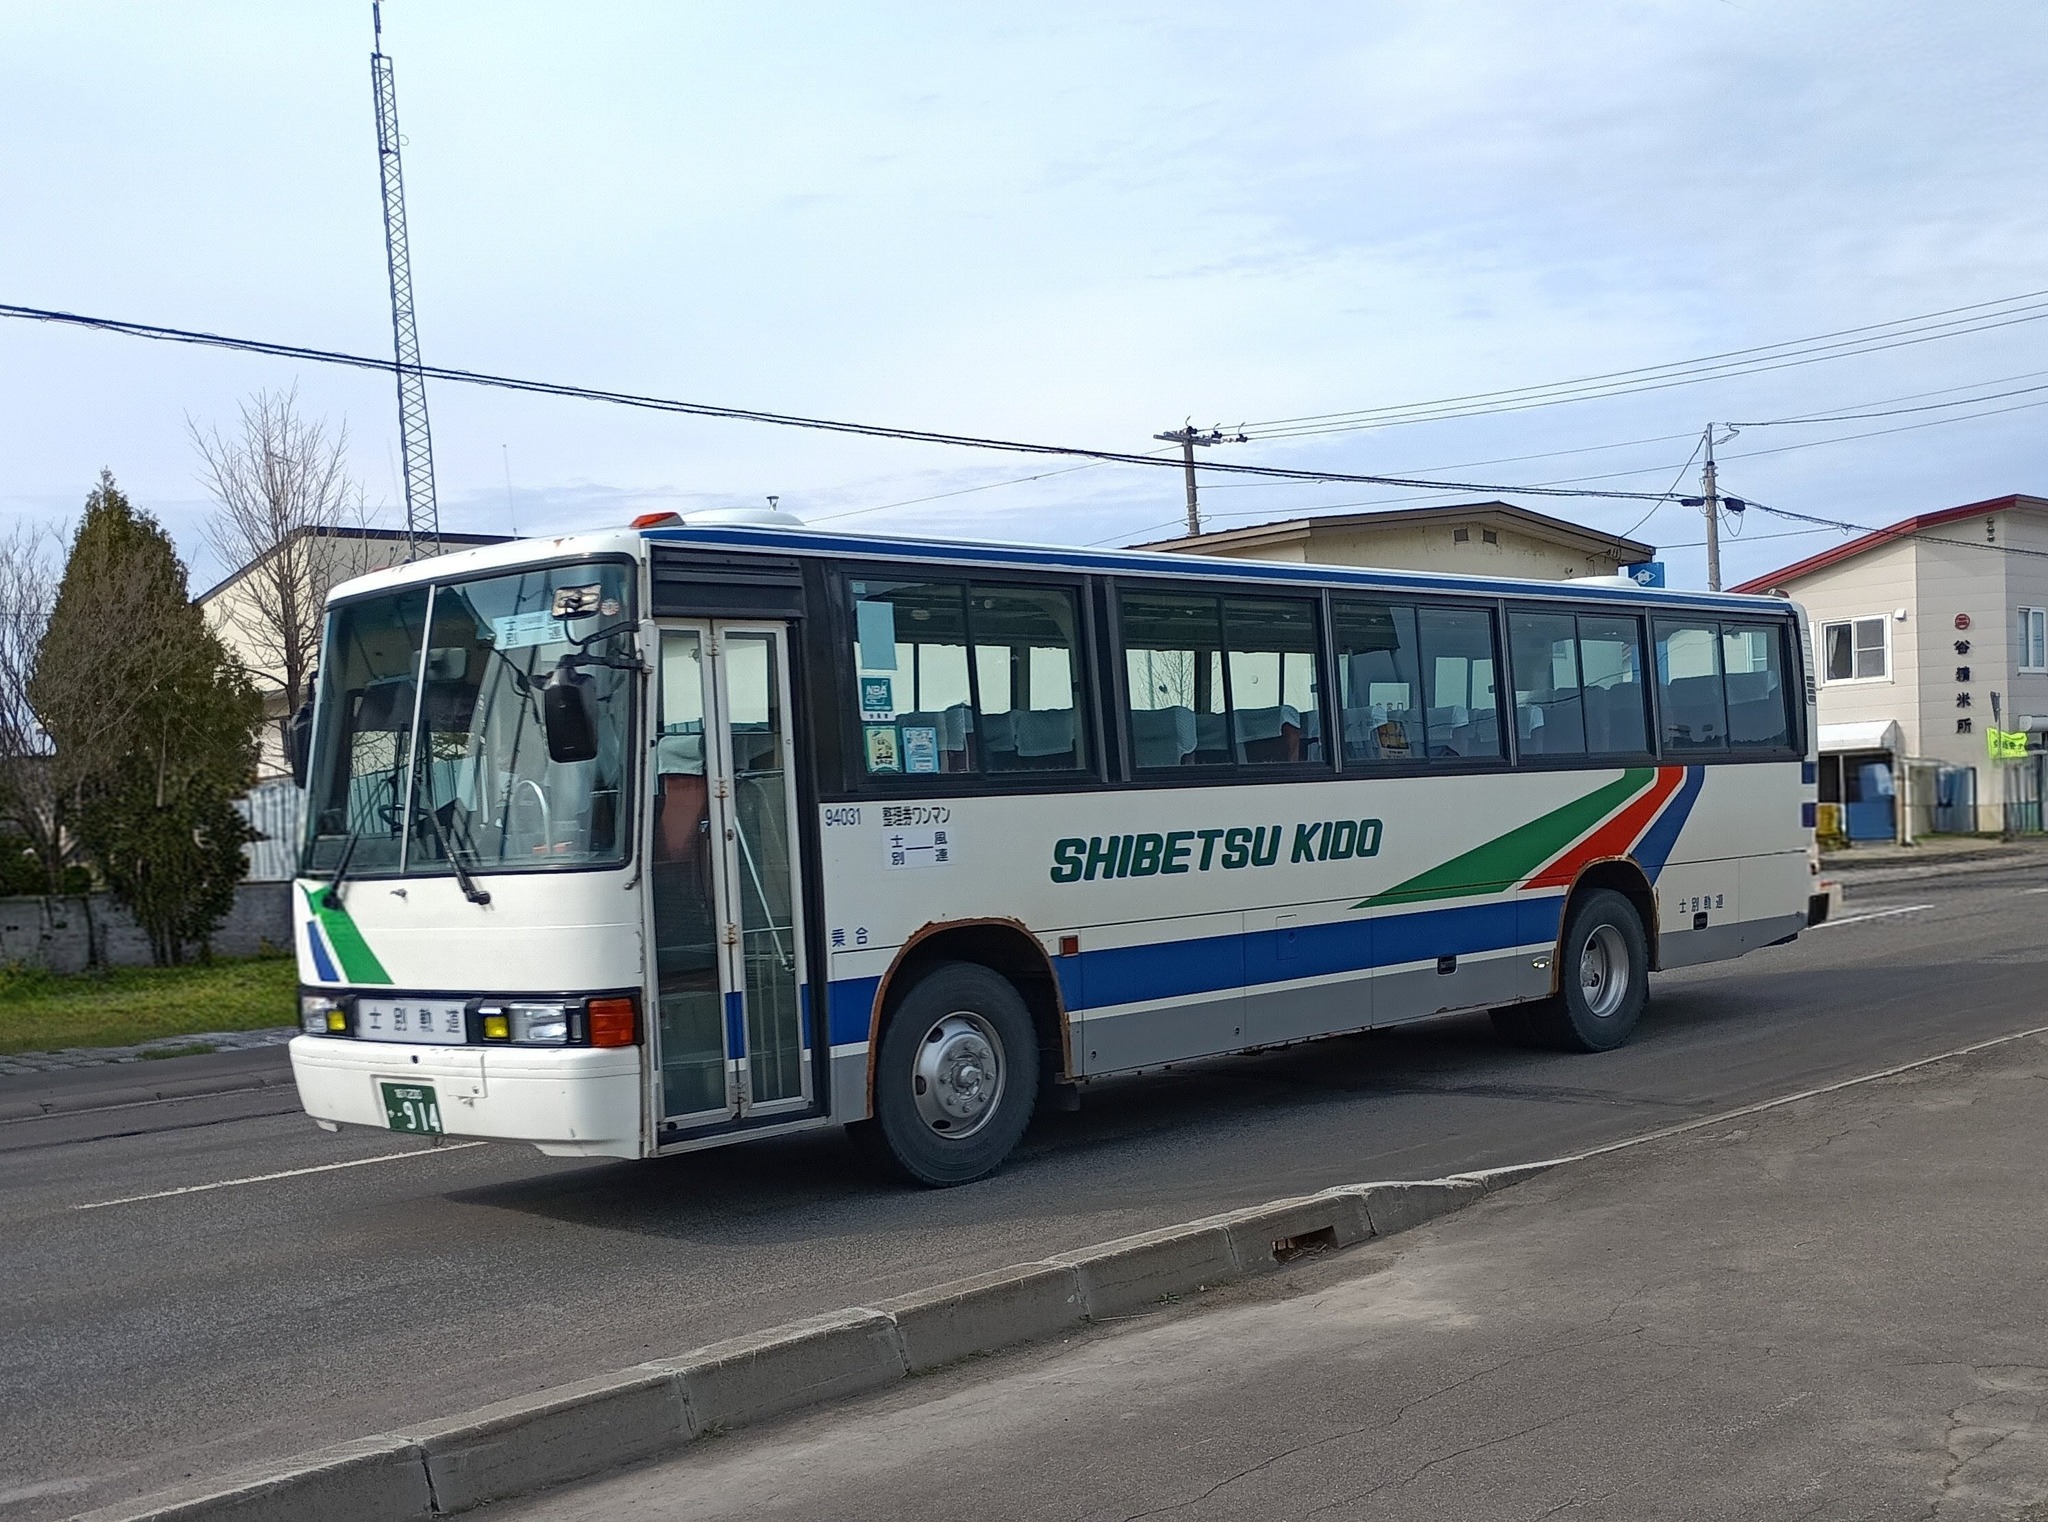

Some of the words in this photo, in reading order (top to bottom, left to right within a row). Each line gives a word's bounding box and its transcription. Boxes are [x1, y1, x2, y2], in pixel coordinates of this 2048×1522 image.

[825, 807, 862, 827] 94031
[882, 807, 951, 827] 整理券ワンマン
[934, 831, 950, 862] 風連
[1050, 825, 1283, 884] SHIBETSU
[1290, 817, 1384, 864] KIDO
